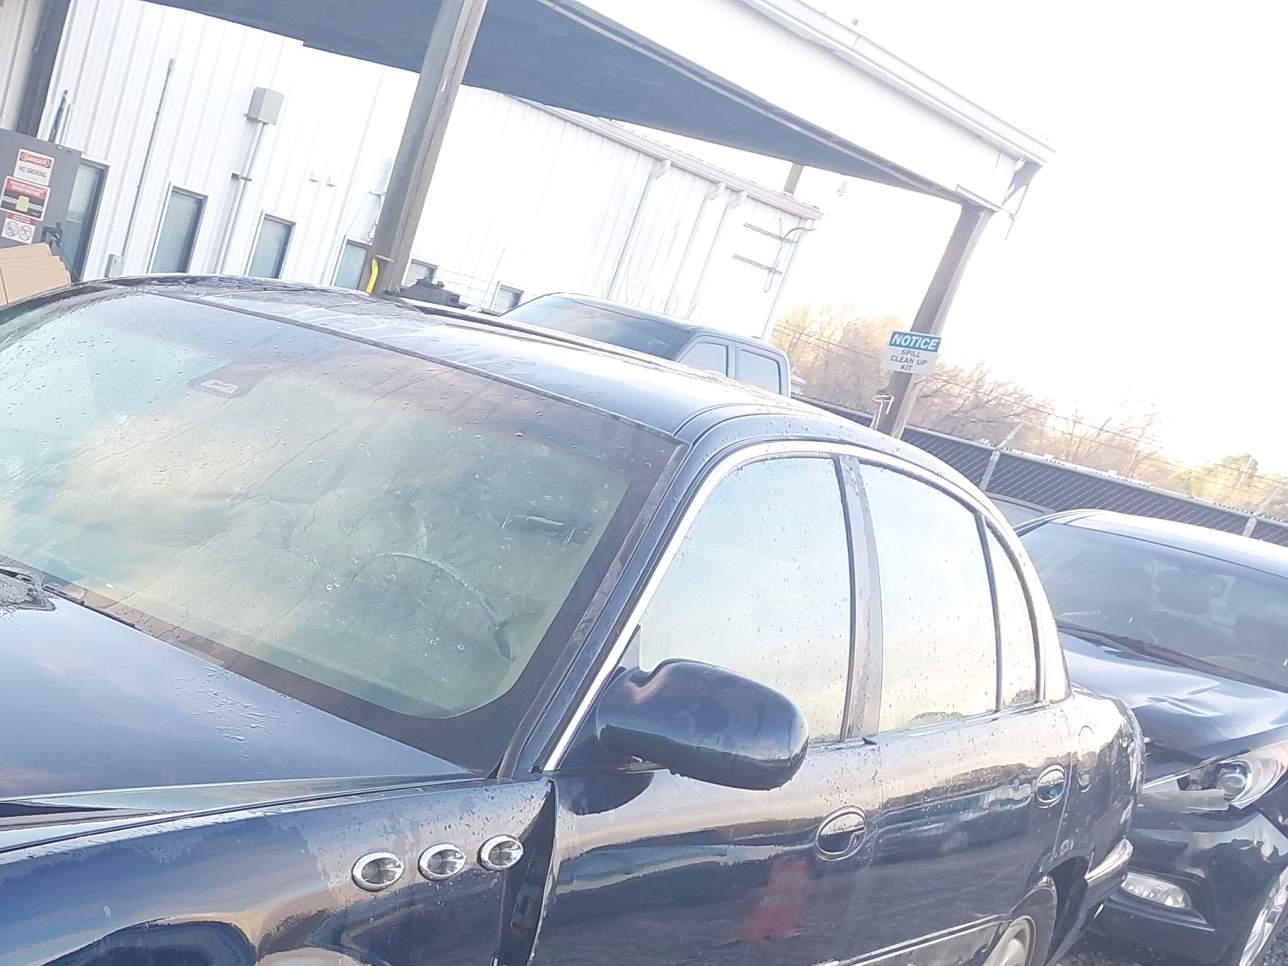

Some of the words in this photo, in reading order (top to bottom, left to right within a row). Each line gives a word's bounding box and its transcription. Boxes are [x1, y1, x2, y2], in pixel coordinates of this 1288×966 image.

[891, 333, 939, 350] NOTICE
[901, 350, 920, 358] SPILL
[890, 355, 914, 364] CLEAN
